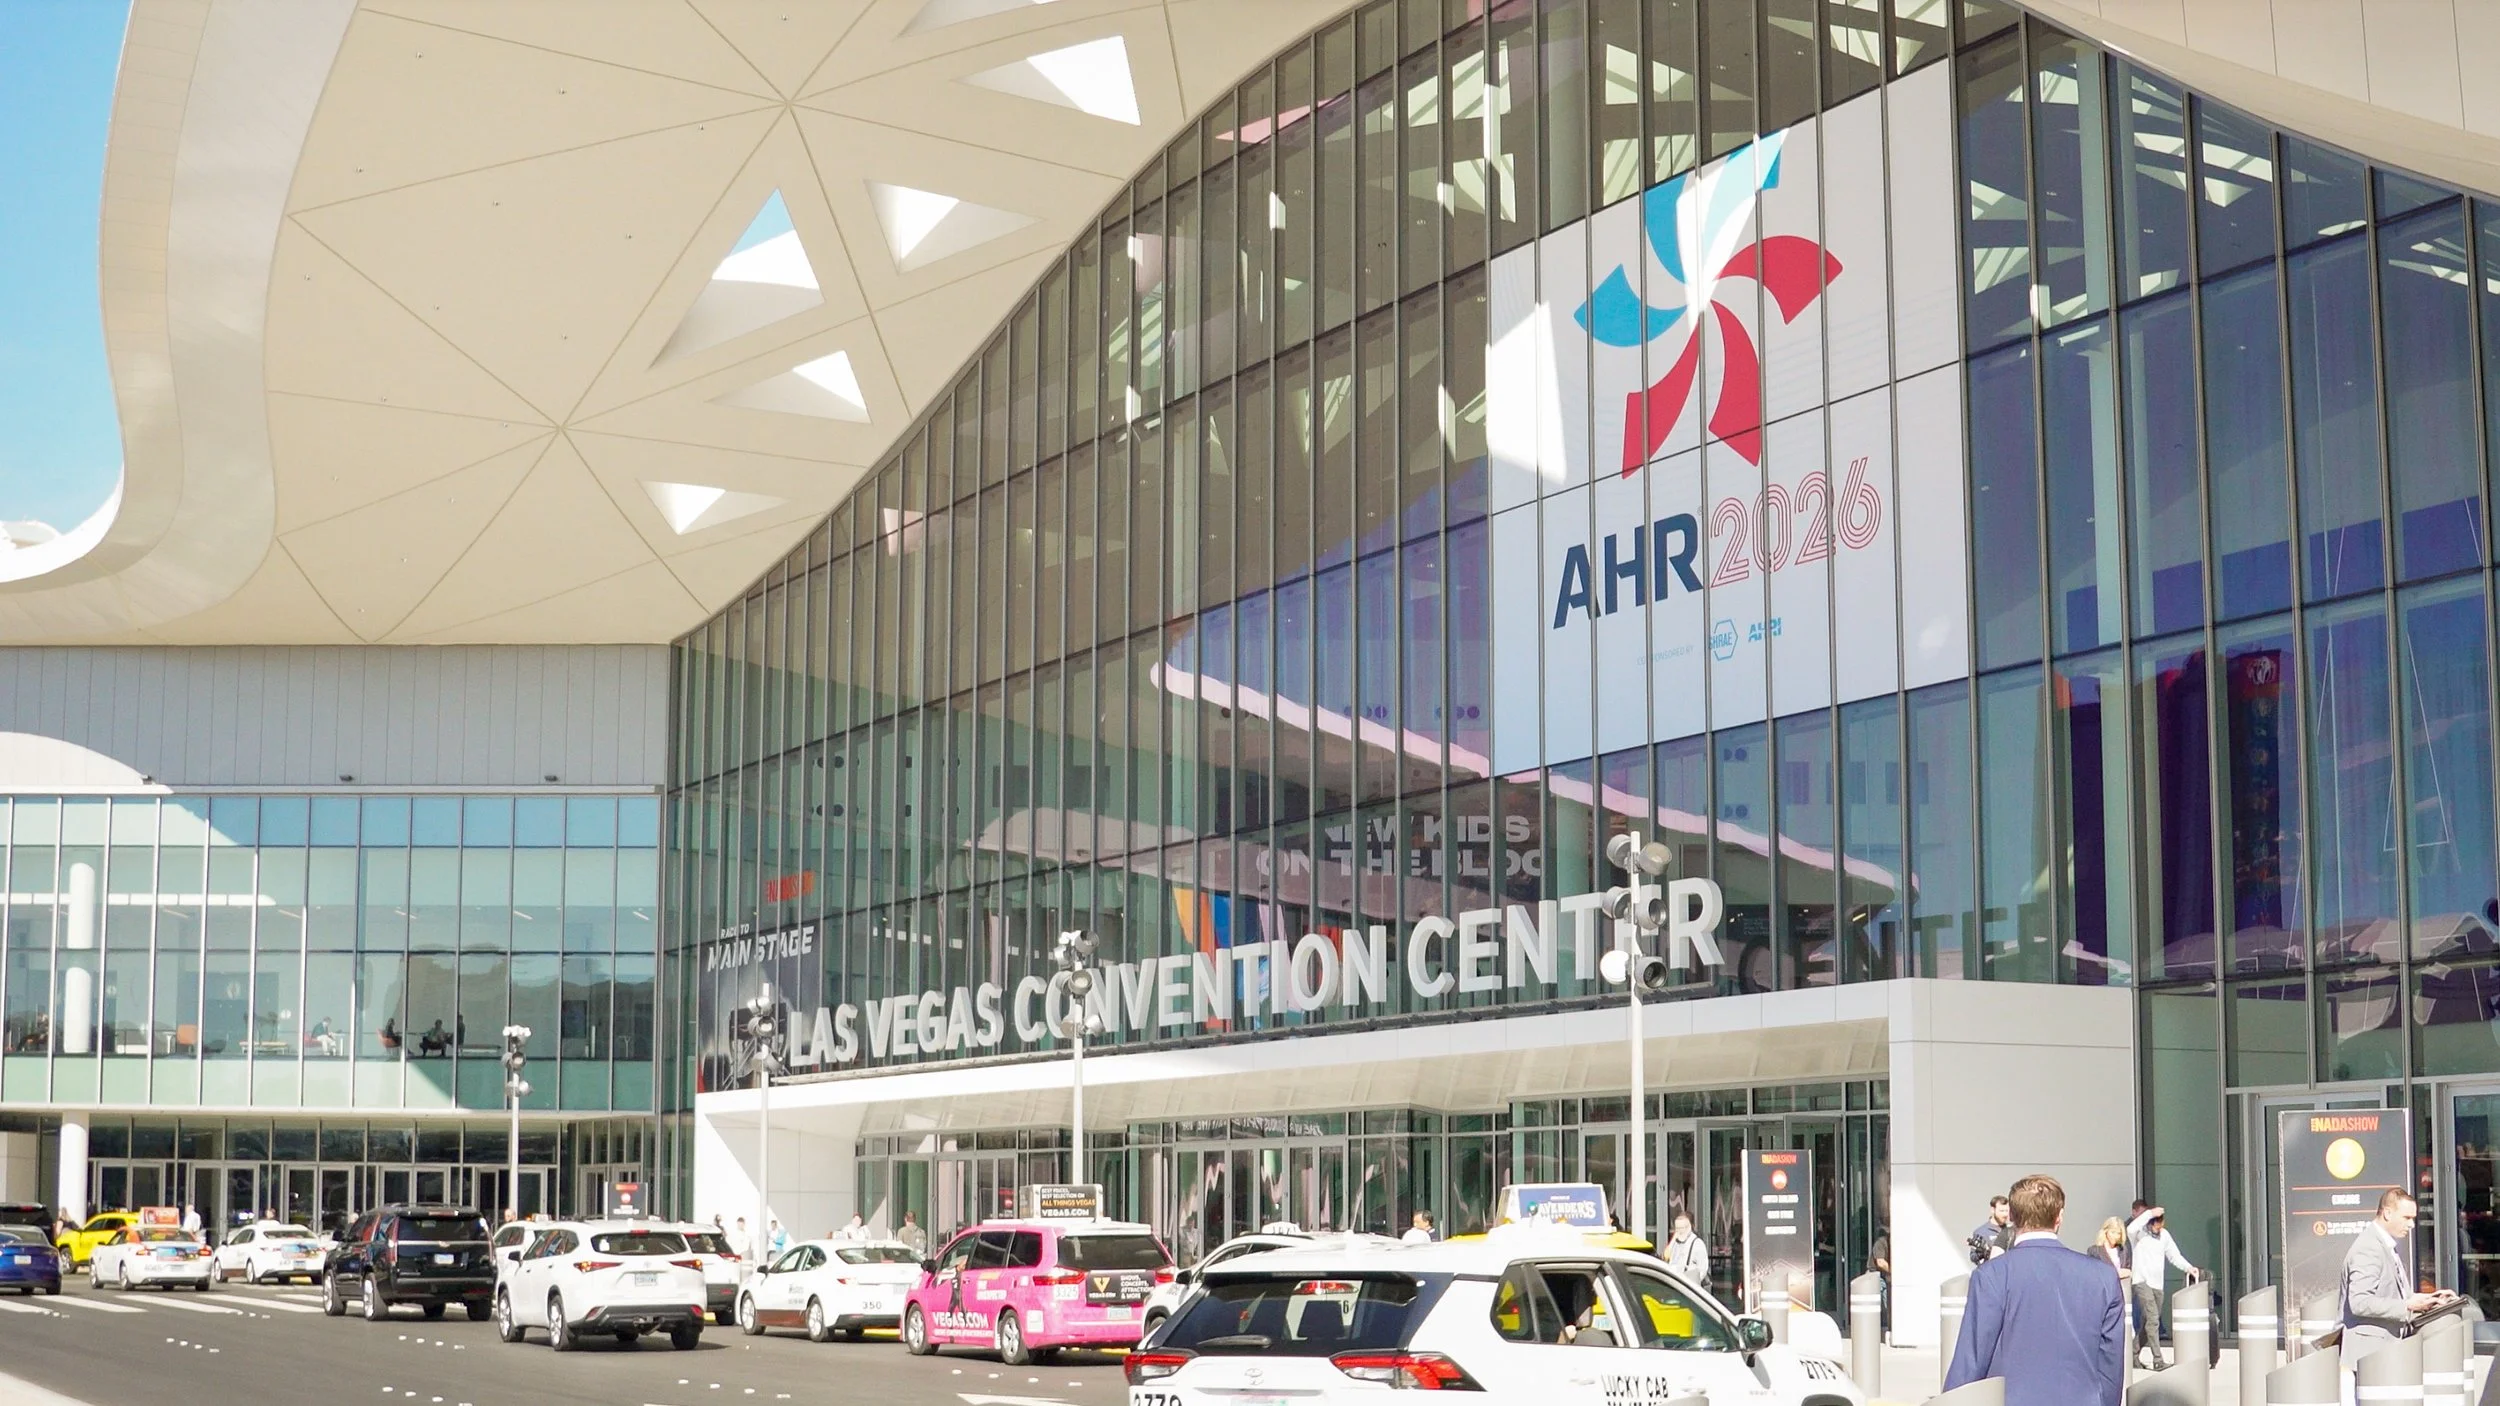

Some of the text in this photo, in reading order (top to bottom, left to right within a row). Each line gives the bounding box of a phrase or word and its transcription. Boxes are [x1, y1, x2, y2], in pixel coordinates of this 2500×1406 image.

[1553, 457, 1882, 629] AHR 2026
[1709, 631, 1733, 650] SHRAE
[1423, 815, 1530, 843] KIDS
[1256, 849, 1312, 877] ON
[1330, 849, 1422, 877] THE
[707, 925, 815, 973] MAIN STAGE
[790, 1003, 858, 1067] LAS
[865, 982, 1004, 1058] VEGAS
[1014, 925, 1387, 1042] CONVENTION
[1041, 1208, 1089, 1217] VEGAS.COM
[862, 1301, 882, 1310] 350
[932, 1311, 989, 1328] VEGAS.COM
[1799, 1359, 1837, 1380] 2779
[1600, 1374, 1669, 1399] LUCKY CAB
